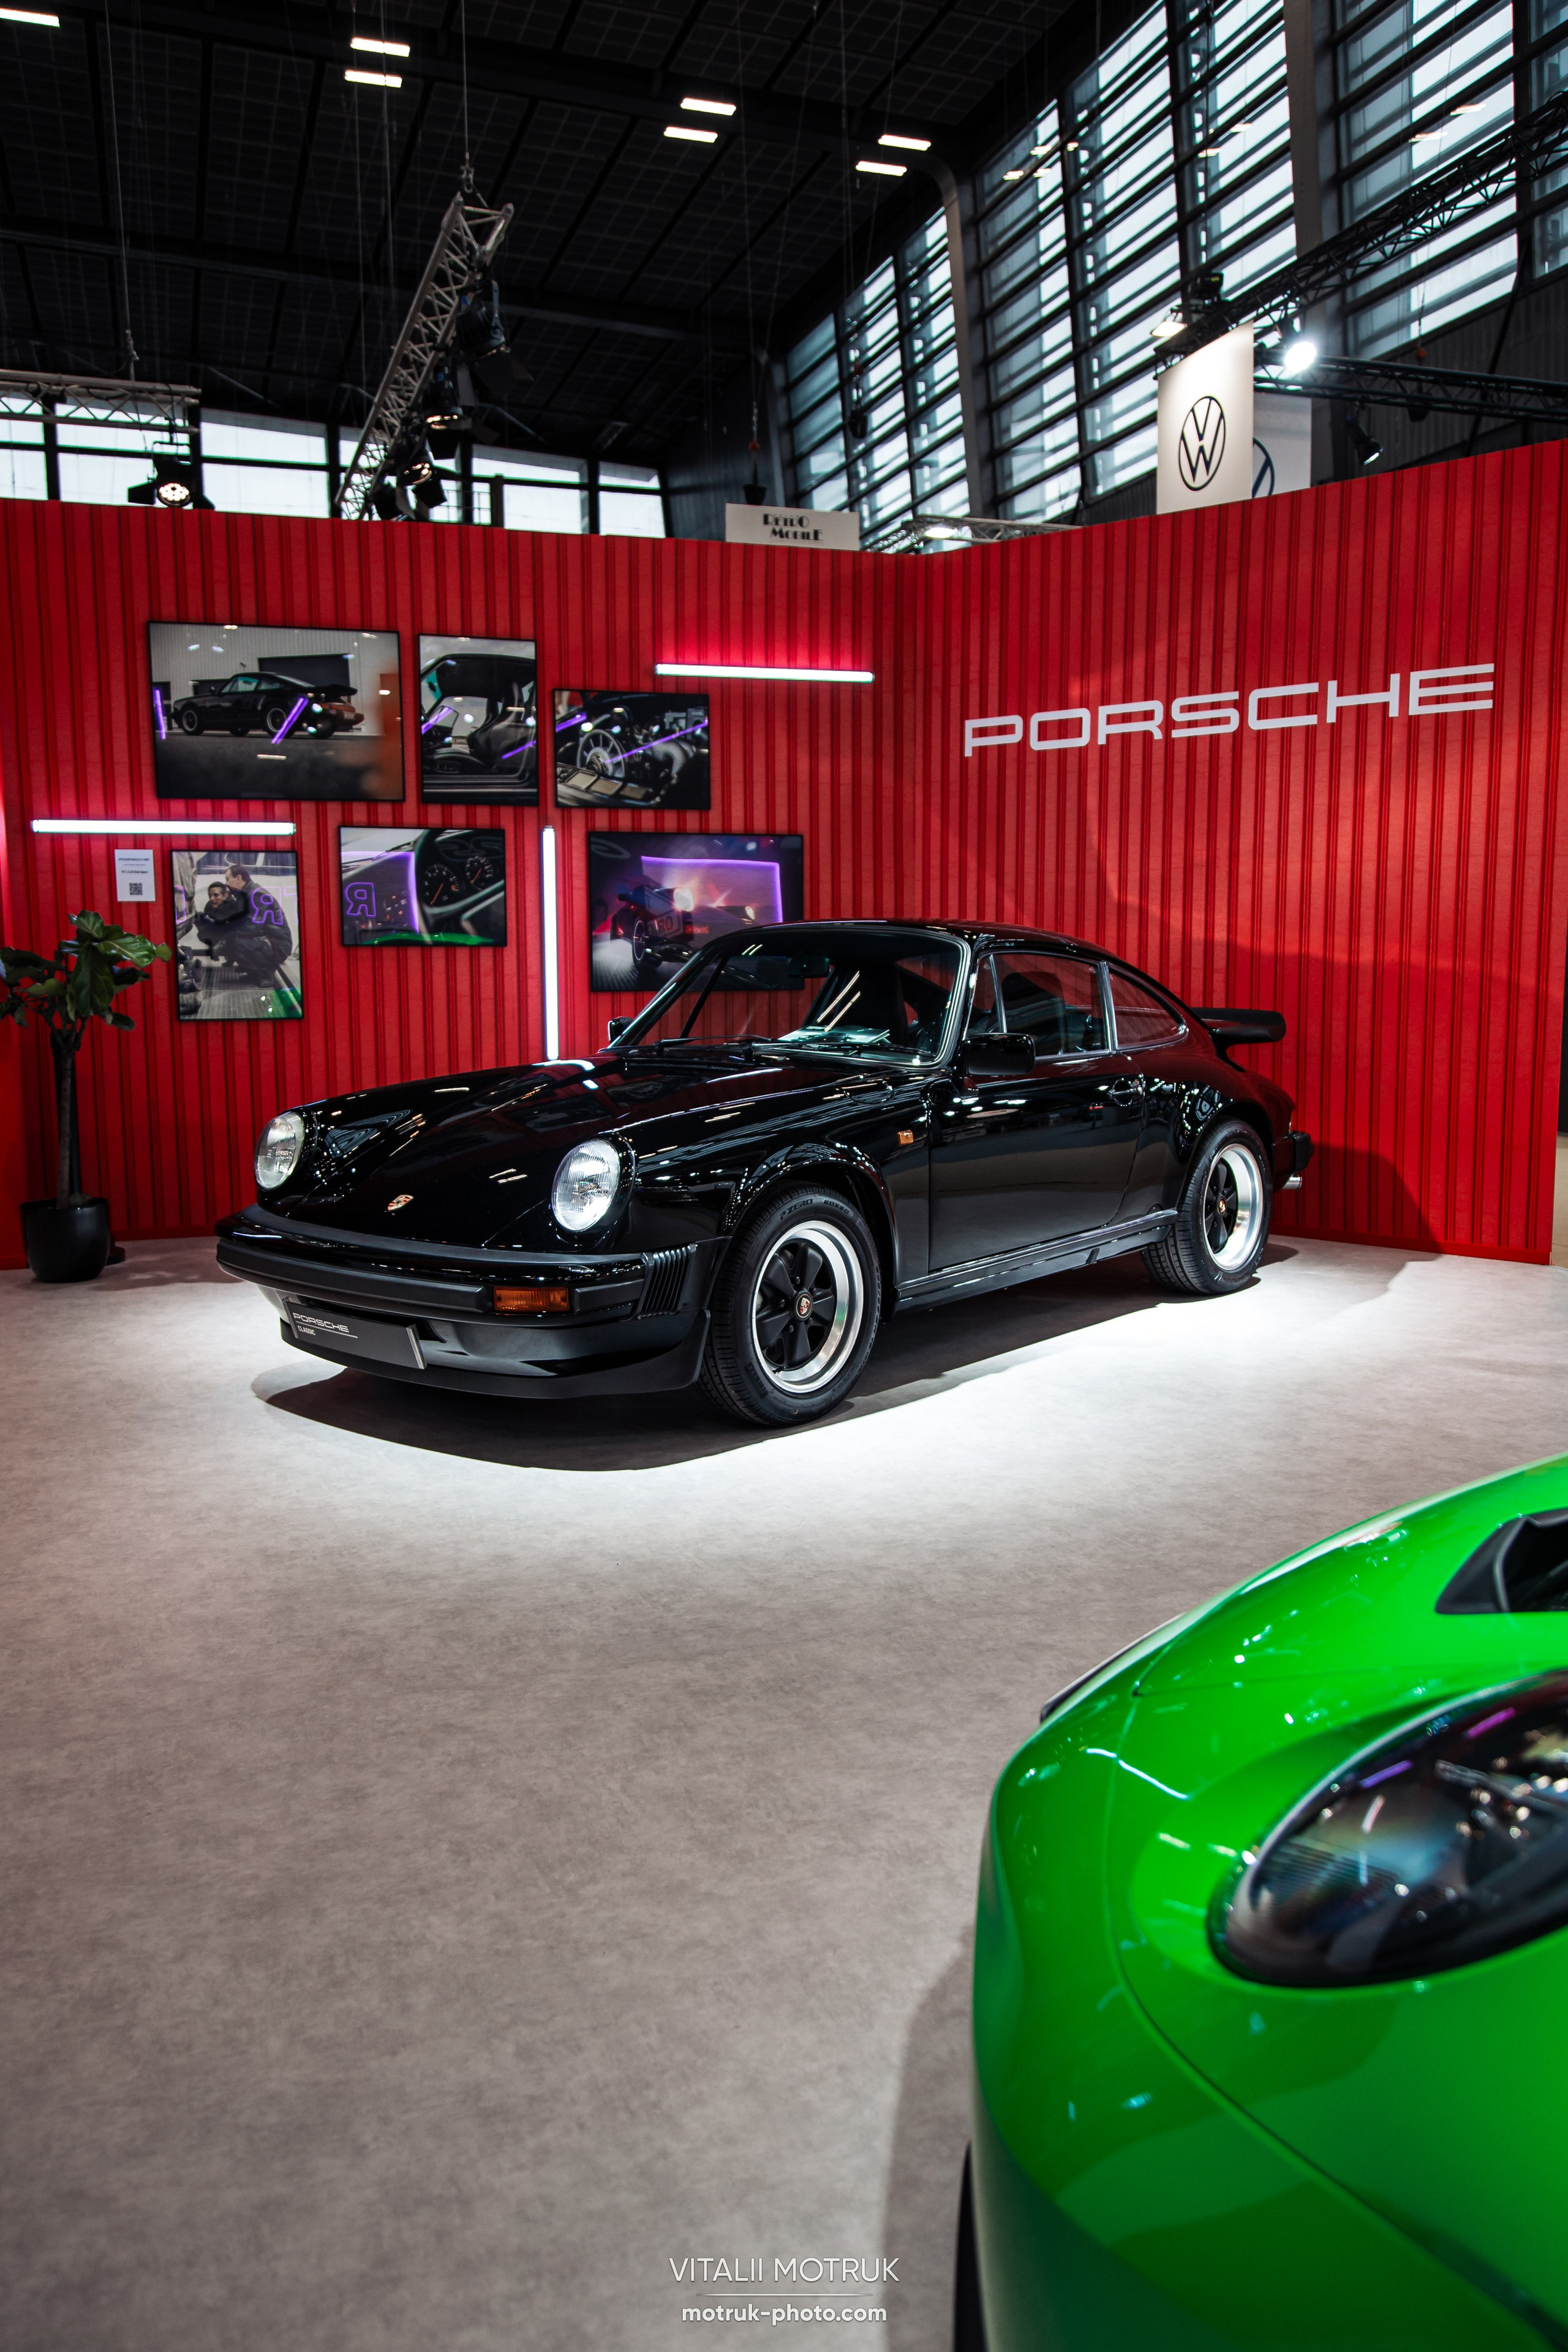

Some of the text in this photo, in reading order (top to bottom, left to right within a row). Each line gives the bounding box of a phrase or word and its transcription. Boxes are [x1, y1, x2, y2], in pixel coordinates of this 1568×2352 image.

[965, 663, 1494, 756] PORSCHE
[823, 1199, 850, 1215] ROSSO
[292, 1313, 350, 1333] PORSCHE
[297, 1325, 316, 1336] CLASSIC
